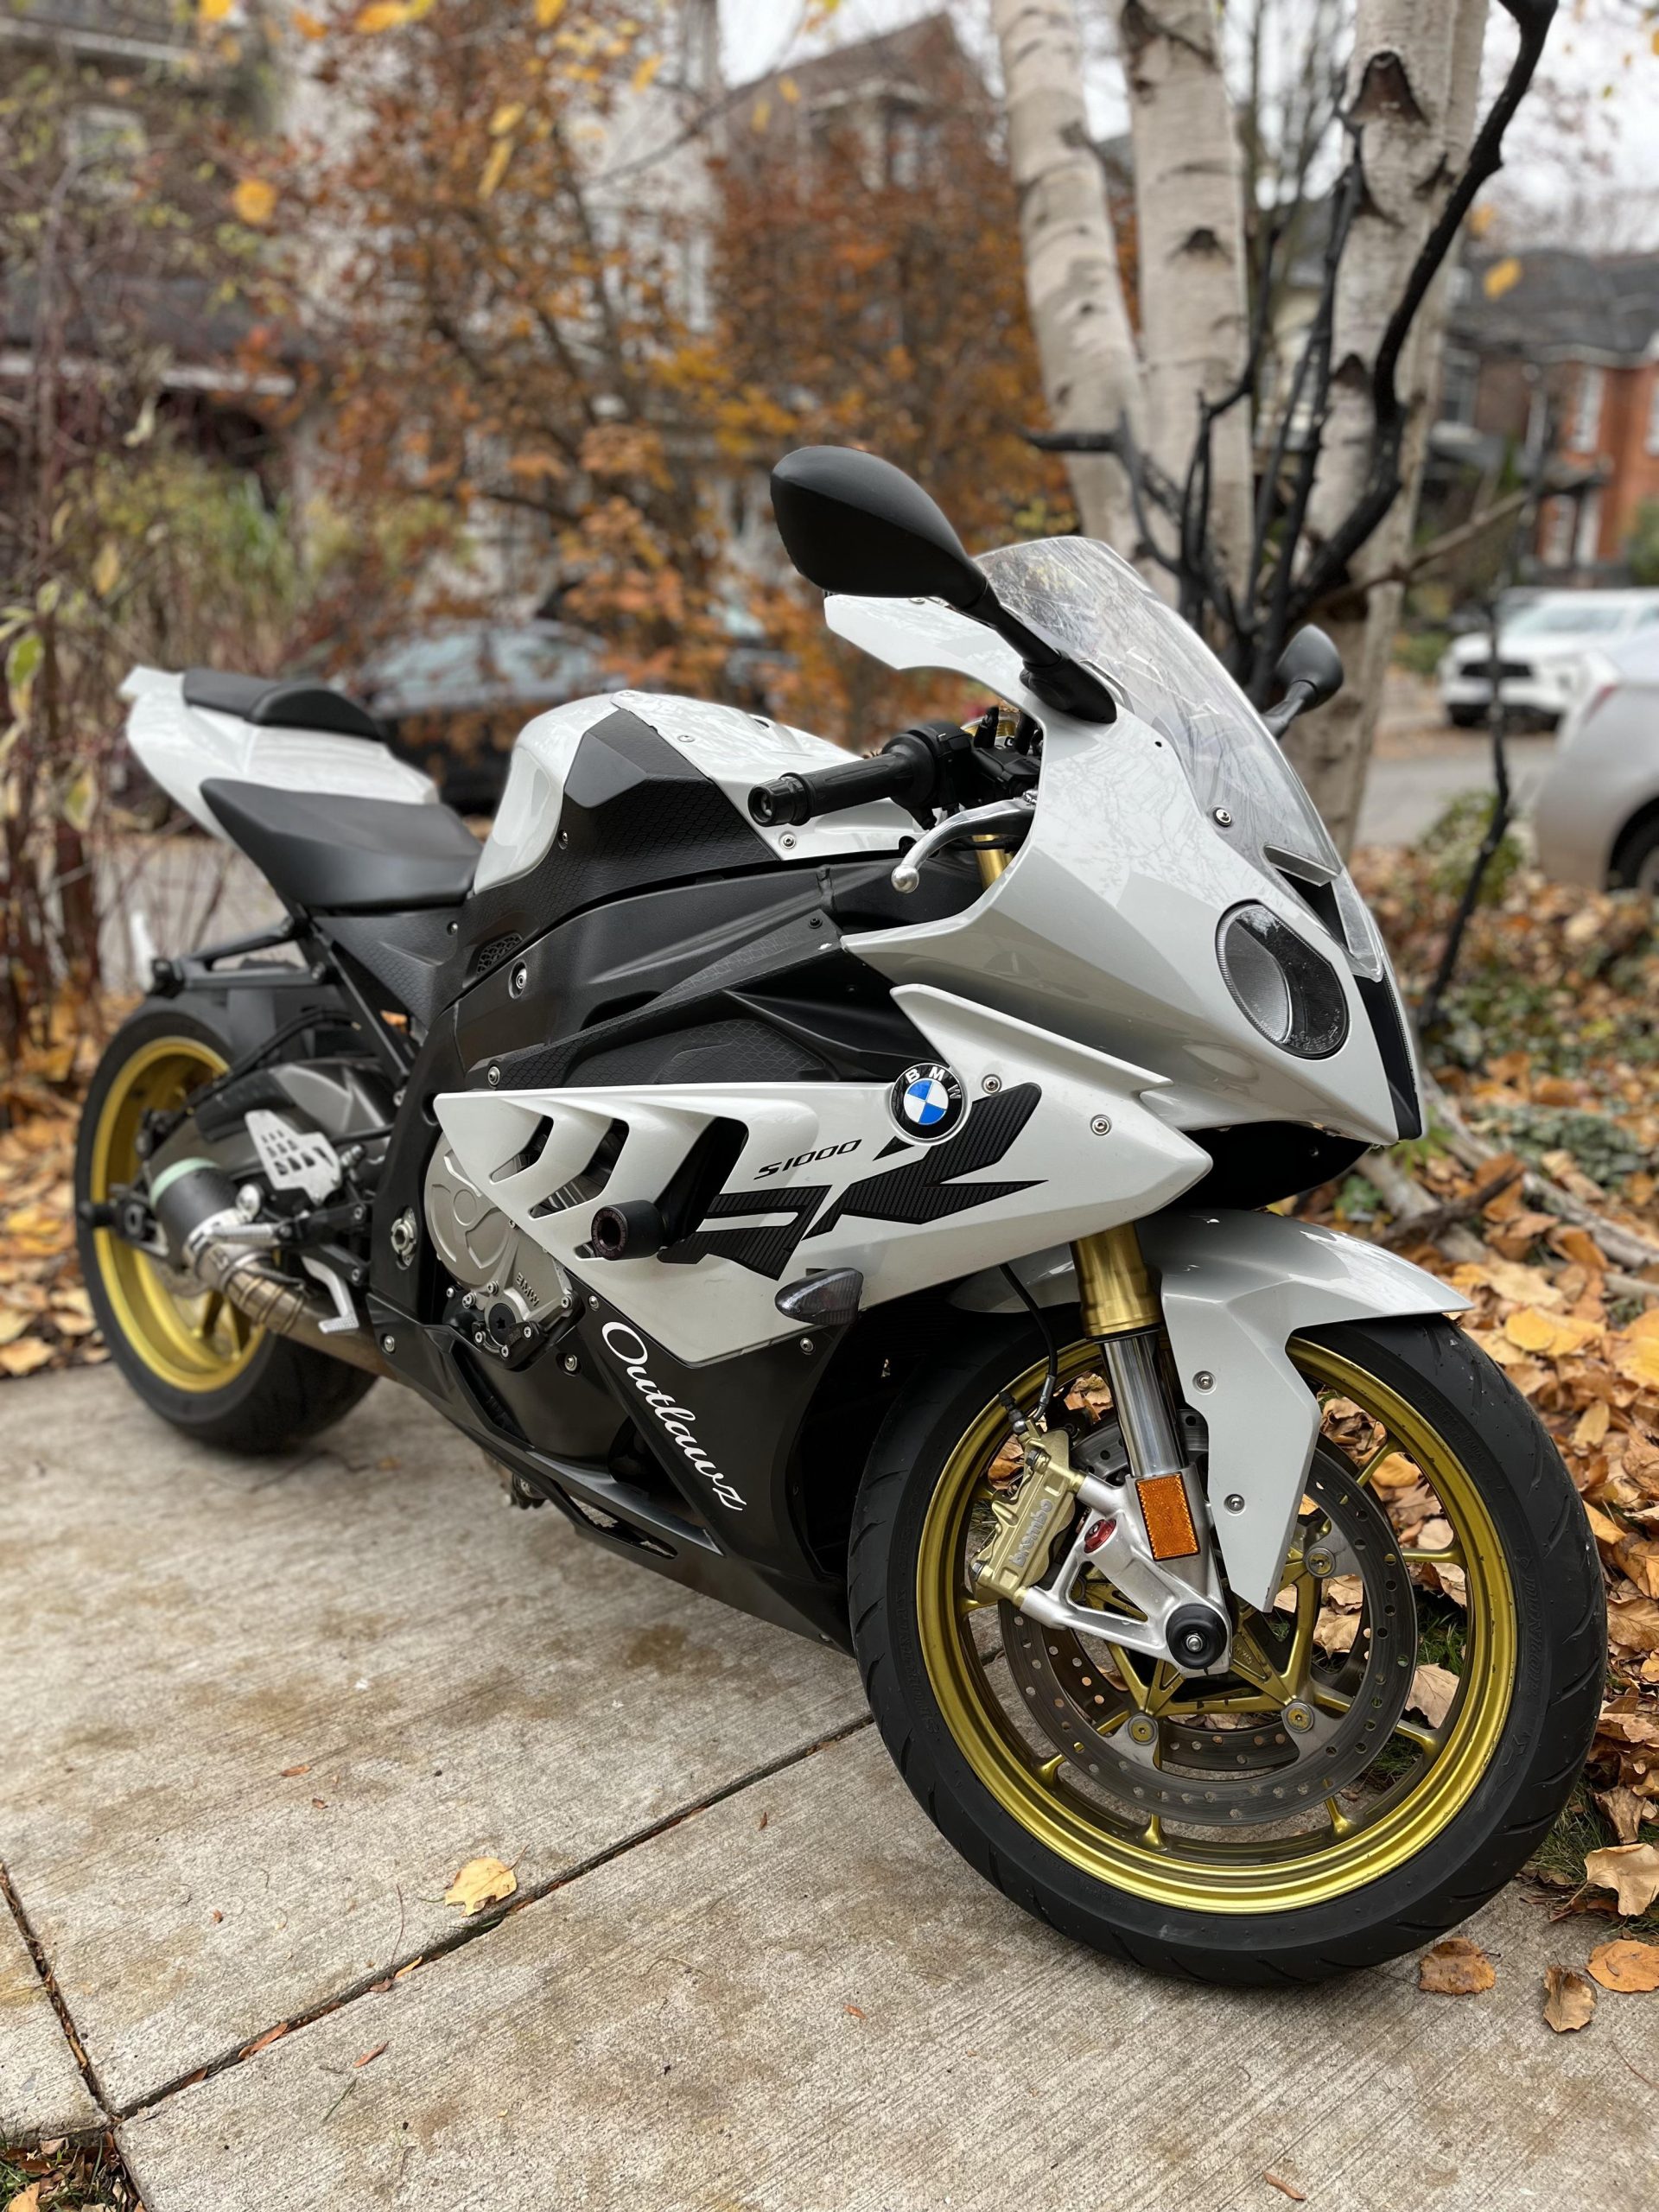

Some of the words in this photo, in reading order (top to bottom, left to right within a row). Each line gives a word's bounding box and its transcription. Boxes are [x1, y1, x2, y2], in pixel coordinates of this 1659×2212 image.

[905, 1065, 962, 1100] BMW
[753, 1139, 862, 1180] S1000
[516, 1271, 540, 1307] BMW
[601, 1321, 747, 1511] Outlawz
[1008, 1498, 1053, 1568] brembo
